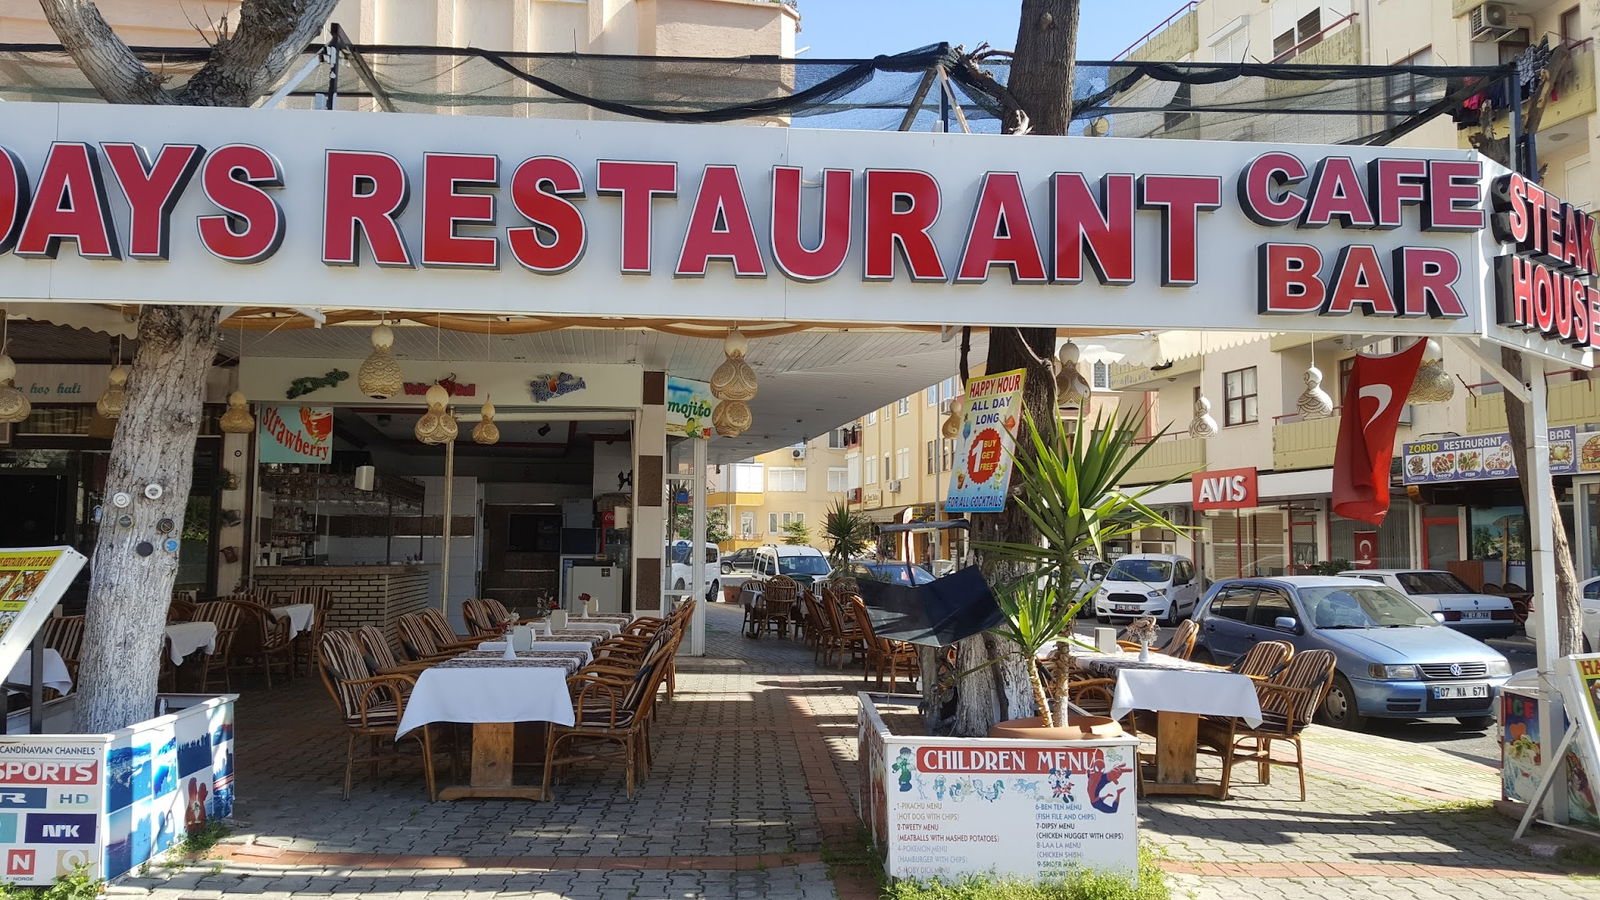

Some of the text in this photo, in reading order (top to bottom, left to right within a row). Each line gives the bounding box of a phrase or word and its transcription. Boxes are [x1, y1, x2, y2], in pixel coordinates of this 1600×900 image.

[1237, 151, 1485, 232] CAFE
[321, 149, 1222, 288] RESTAURANT
[1491, 172, 1599, 278] STEAK
[1257, 242, 1467, 319] BAR
[1494, 253, 1600, 350] HOUSE
[969, 374, 1021, 399] HAPPY HOUR
[667, 399, 712, 418] mojito
[971, 396, 1012, 412] ALL DAY
[976, 413, 1000, 425] LONG
[263, 407, 329, 460] strawberry
[983, 440, 997, 448] BUY
[1408, 429, 1571, 454] ZORRO RESTAURANT BAR
[971, 440, 984, 473] 1
[981, 450, 995, 459] GET
[980, 462, 994, 471] FREE
[1199, 475, 1247, 503] AVIS
[948, 495, 1002, 507] FOR ALL COCKTAILS
[1441, 686, 1486, 697] 07 NA 671
[1506, 697, 1534, 719] ICE
[55, 746, 95, 755] CHANNELS
[923, 750, 1097, 771] CHILDREN MENU
[59, 793, 90, 804] HD
